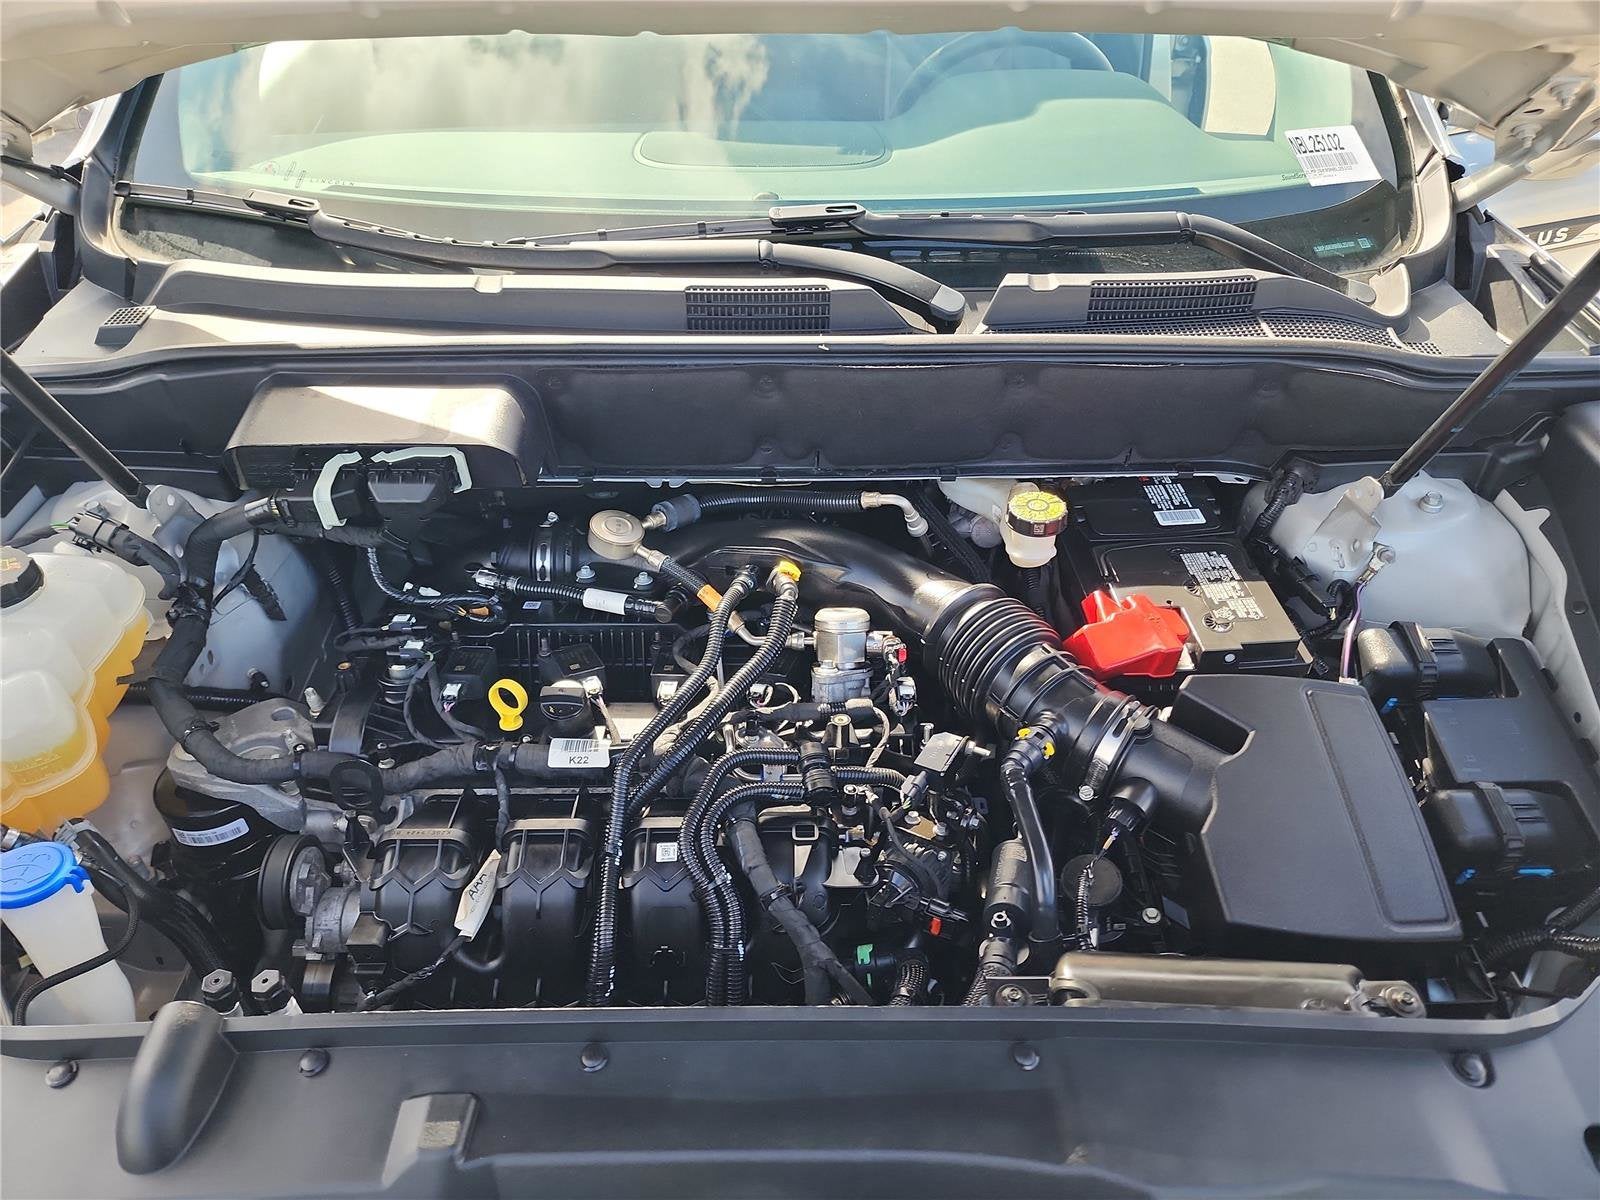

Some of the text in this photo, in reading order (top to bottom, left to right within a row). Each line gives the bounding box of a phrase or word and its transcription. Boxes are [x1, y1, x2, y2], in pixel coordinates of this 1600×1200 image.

[1288, 133, 1345, 154] NBL25102
[1524, 227, 1569, 246] US
[568, 756, 590, 765] K22
